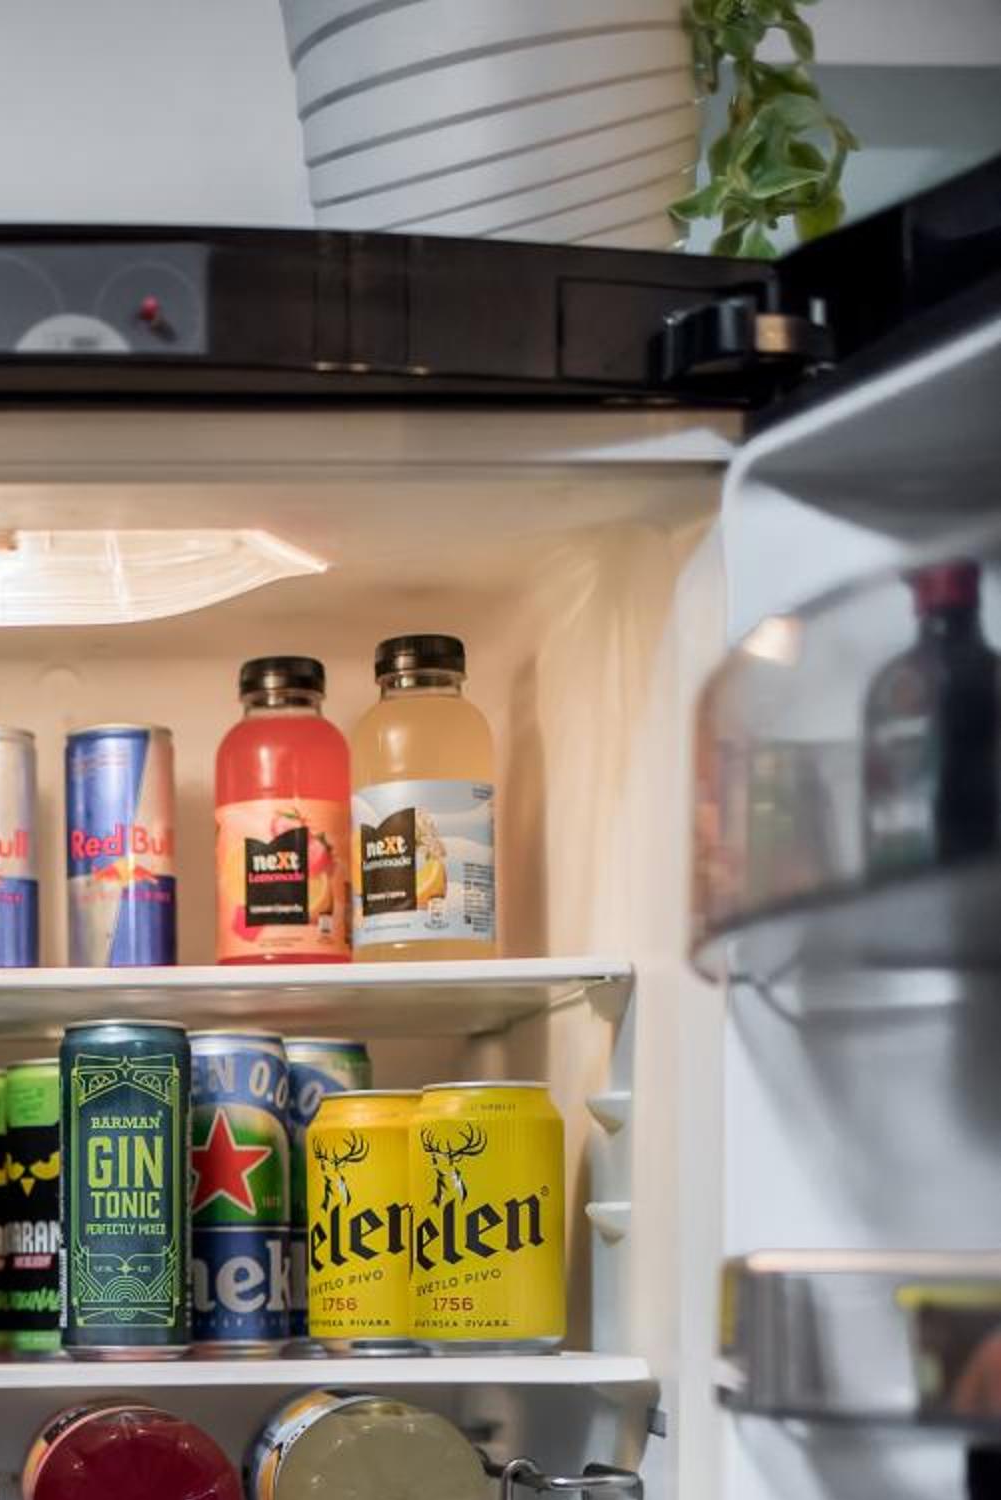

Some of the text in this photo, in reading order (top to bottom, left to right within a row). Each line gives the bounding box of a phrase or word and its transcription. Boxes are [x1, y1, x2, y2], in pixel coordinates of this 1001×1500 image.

[70, 820, 126, 860] Red
[90, 1116, 161, 1130] BARMAN
[86, 1135, 164, 1189] GIN
[90, 1191, 161, 1219] TONIC
[85, 1223, 168, 1236] PERFECTLY MIXED
[348, 1269, 384, 1286] PIVO
[464, 1268, 502, 1285] PIVO
[322, 1298, 358, 1312] 1756
[433, 1297, 474, 1313] 1756
